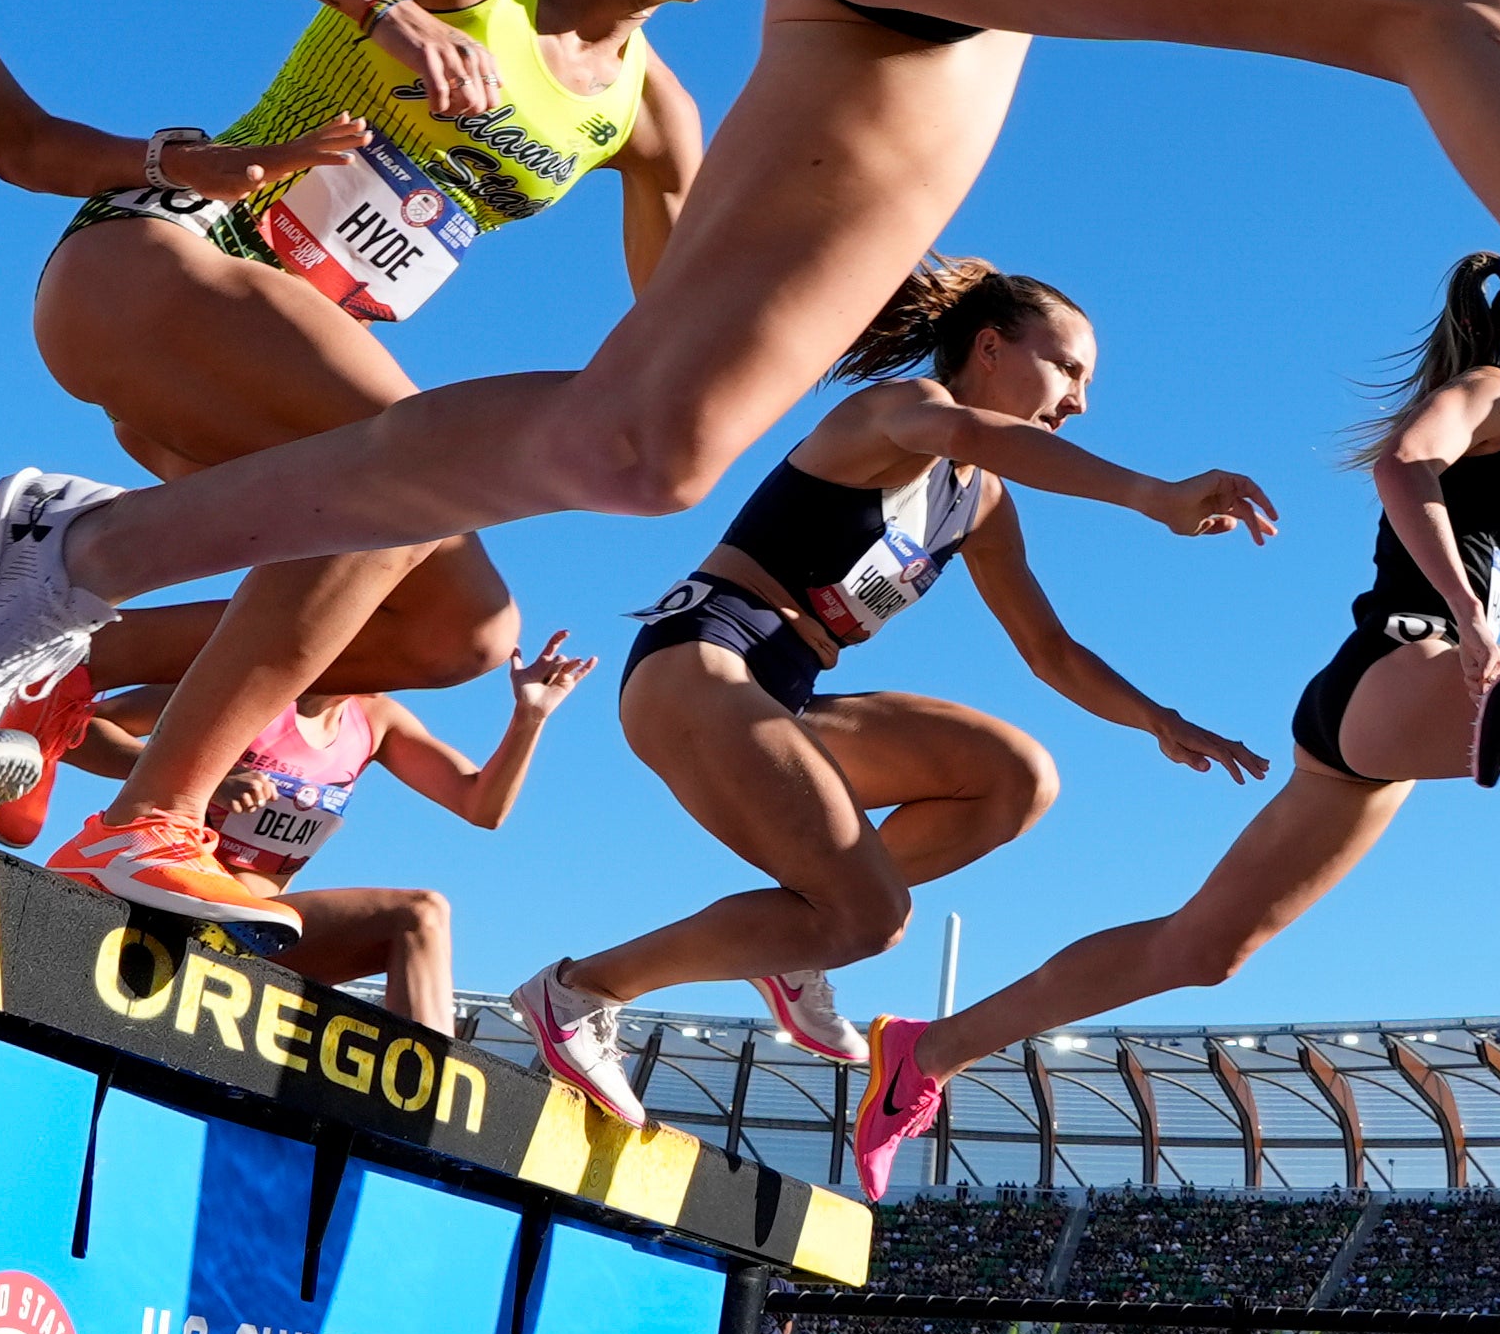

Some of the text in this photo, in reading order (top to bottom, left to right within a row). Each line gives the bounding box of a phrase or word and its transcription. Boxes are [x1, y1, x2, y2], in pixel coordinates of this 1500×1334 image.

[376, 149, 412, 183] USATF
[273, 212, 329, 265] TRACKTOWN
[336, 201, 424, 282] HYDE
[243, 750, 304, 777] BEASTS
[254, 808, 323, 845] DELAY
[95, 926, 487, 1134] OREGON
